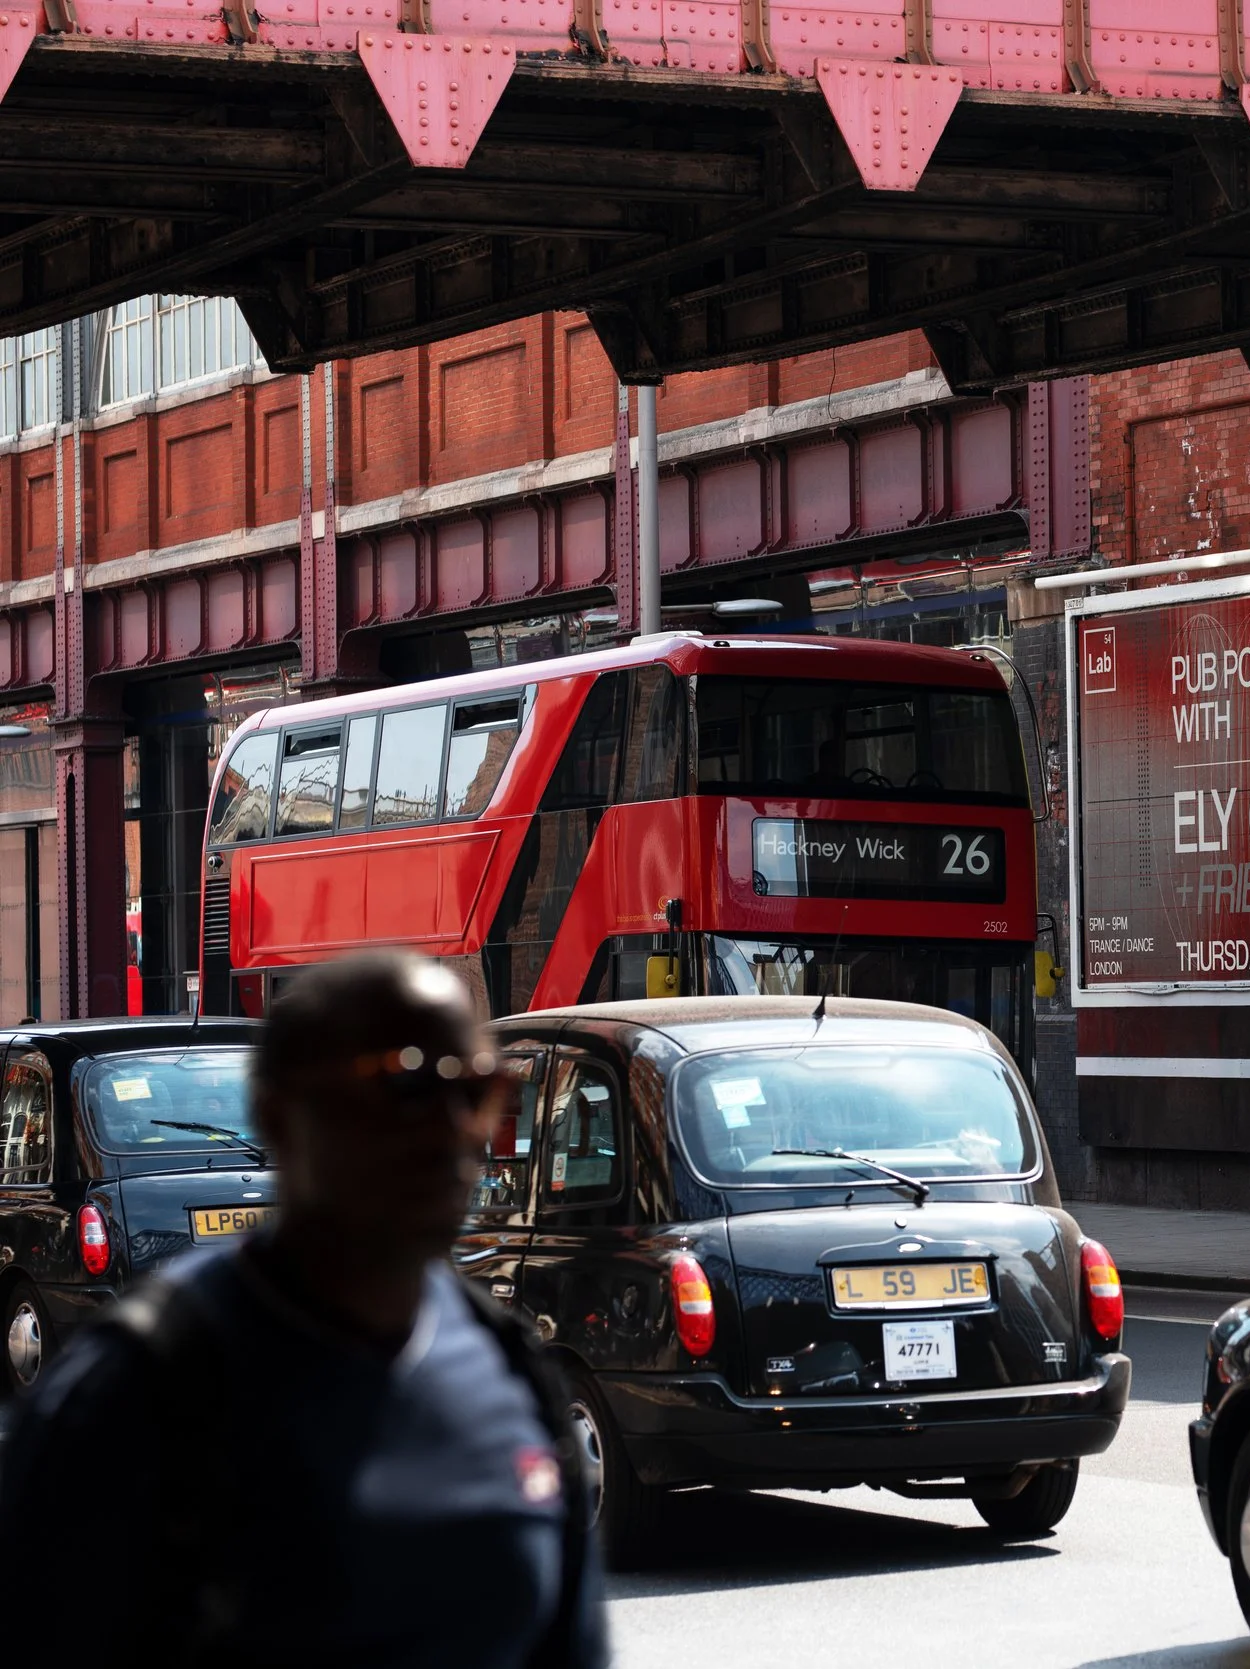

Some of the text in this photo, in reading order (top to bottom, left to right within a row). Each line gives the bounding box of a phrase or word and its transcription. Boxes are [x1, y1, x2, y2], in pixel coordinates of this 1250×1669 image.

[1104, 633, 1112, 644] 54
[1088, 651, 1112, 675] Lab
[1171, 651, 1218, 695] PUB
[1172, 701, 1231, 743] WITH
[1173, 786, 1237, 854] ELY
[760, 833, 990, 875] Hackney Wick 26
[983, 920, 1008, 934] 2502
[1089, 917, 1105, 932] 5PM
[1112, 916, 1128, 931] 9PM
[1089, 939, 1121, 954] TRANCE
[1127, 937, 1154, 953] DANCE
[1089, 961, 1123, 976] LONDON
[204, 1210, 257, 1232] LP60
[897, 1342, 940, 1357] 47771
